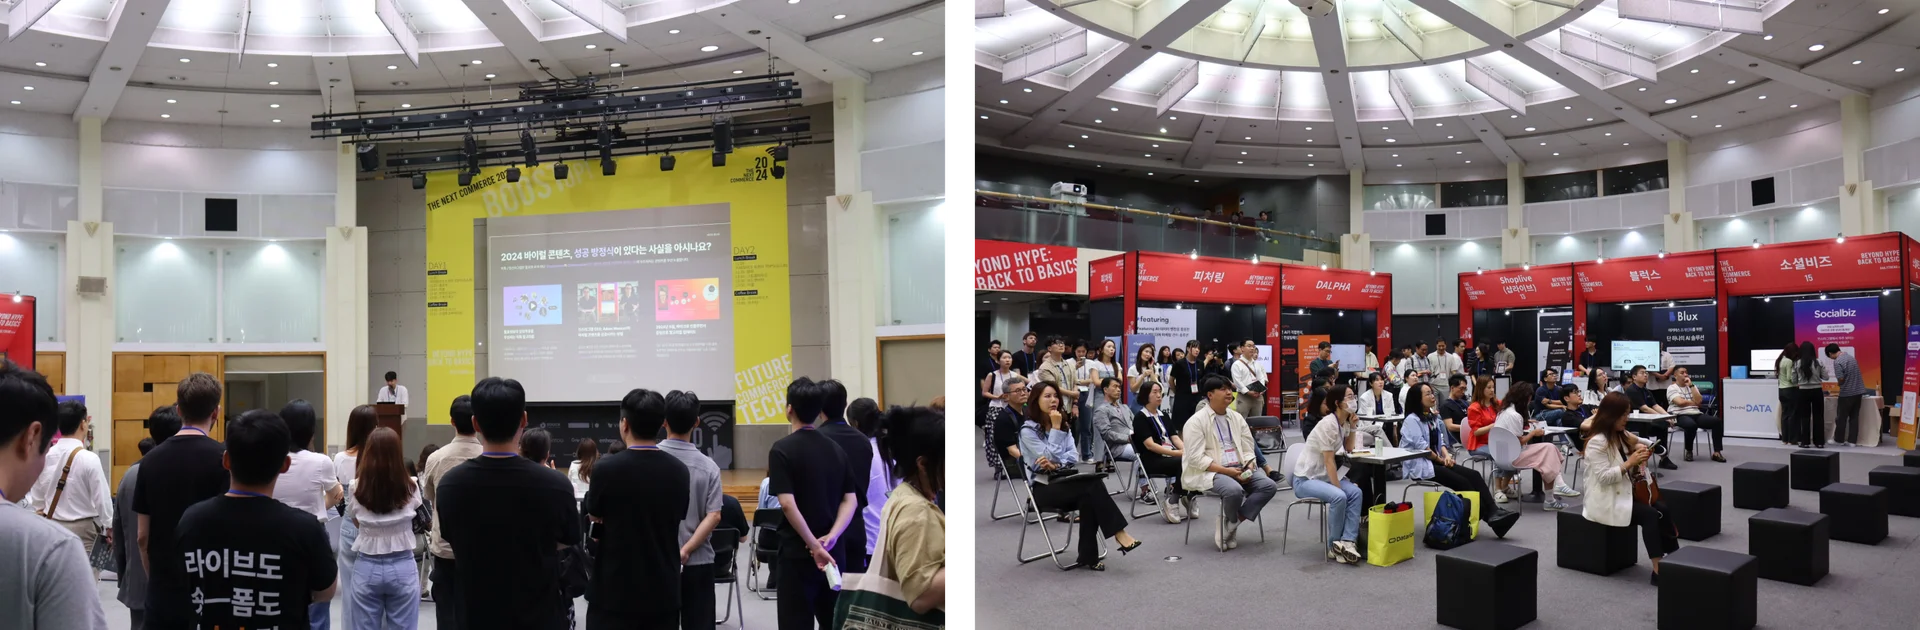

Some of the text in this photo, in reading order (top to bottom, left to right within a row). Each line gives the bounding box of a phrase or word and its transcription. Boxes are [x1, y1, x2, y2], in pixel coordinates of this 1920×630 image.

[755, 156, 768, 168] 20
[756, 169, 768, 181] 24
[427, 200, 441, 212] THE
[440, 192, 458, 205] NEXT
[459, 176, 494, 198] COMMERCE
[501, 242, 712, 261] 2024 바이럴 콘텐츠, 성공 방정식이 있다는 사실을 아시나요?
[734, 246, 755, 255] DAY2
[1014, 247, 1053, 267] HYPE:
[1780, 256, 1832, 270] 소셜비즈
[428, 262, 447, 270] DAY1
[976, 271, 1015, 290] BACK
[1016, 268, 1034, 284] TO
[1193, 270, 1225, 283] 피처링
[1500, 275, 1532, 284] Shoplive
[1630, 270, 1661, 282] 블럭스
[1804, 274, 1813, 282] 15
[1316, 280, 1351, 291] DALPHA
[1677, 311, 1698, 322] Blux
[1814, 308, 1856, 318] Socialbiz
[1140, 316, 1169, 324] featuring
[735, 354, 792, 390] FUTURE
[736, 374, 791, 404] COMMERCE
[738, 391, 787, 424] TECH
[1746, 404, 1772, 412] DATA
[184, 548, 283, 580] 라이브도
